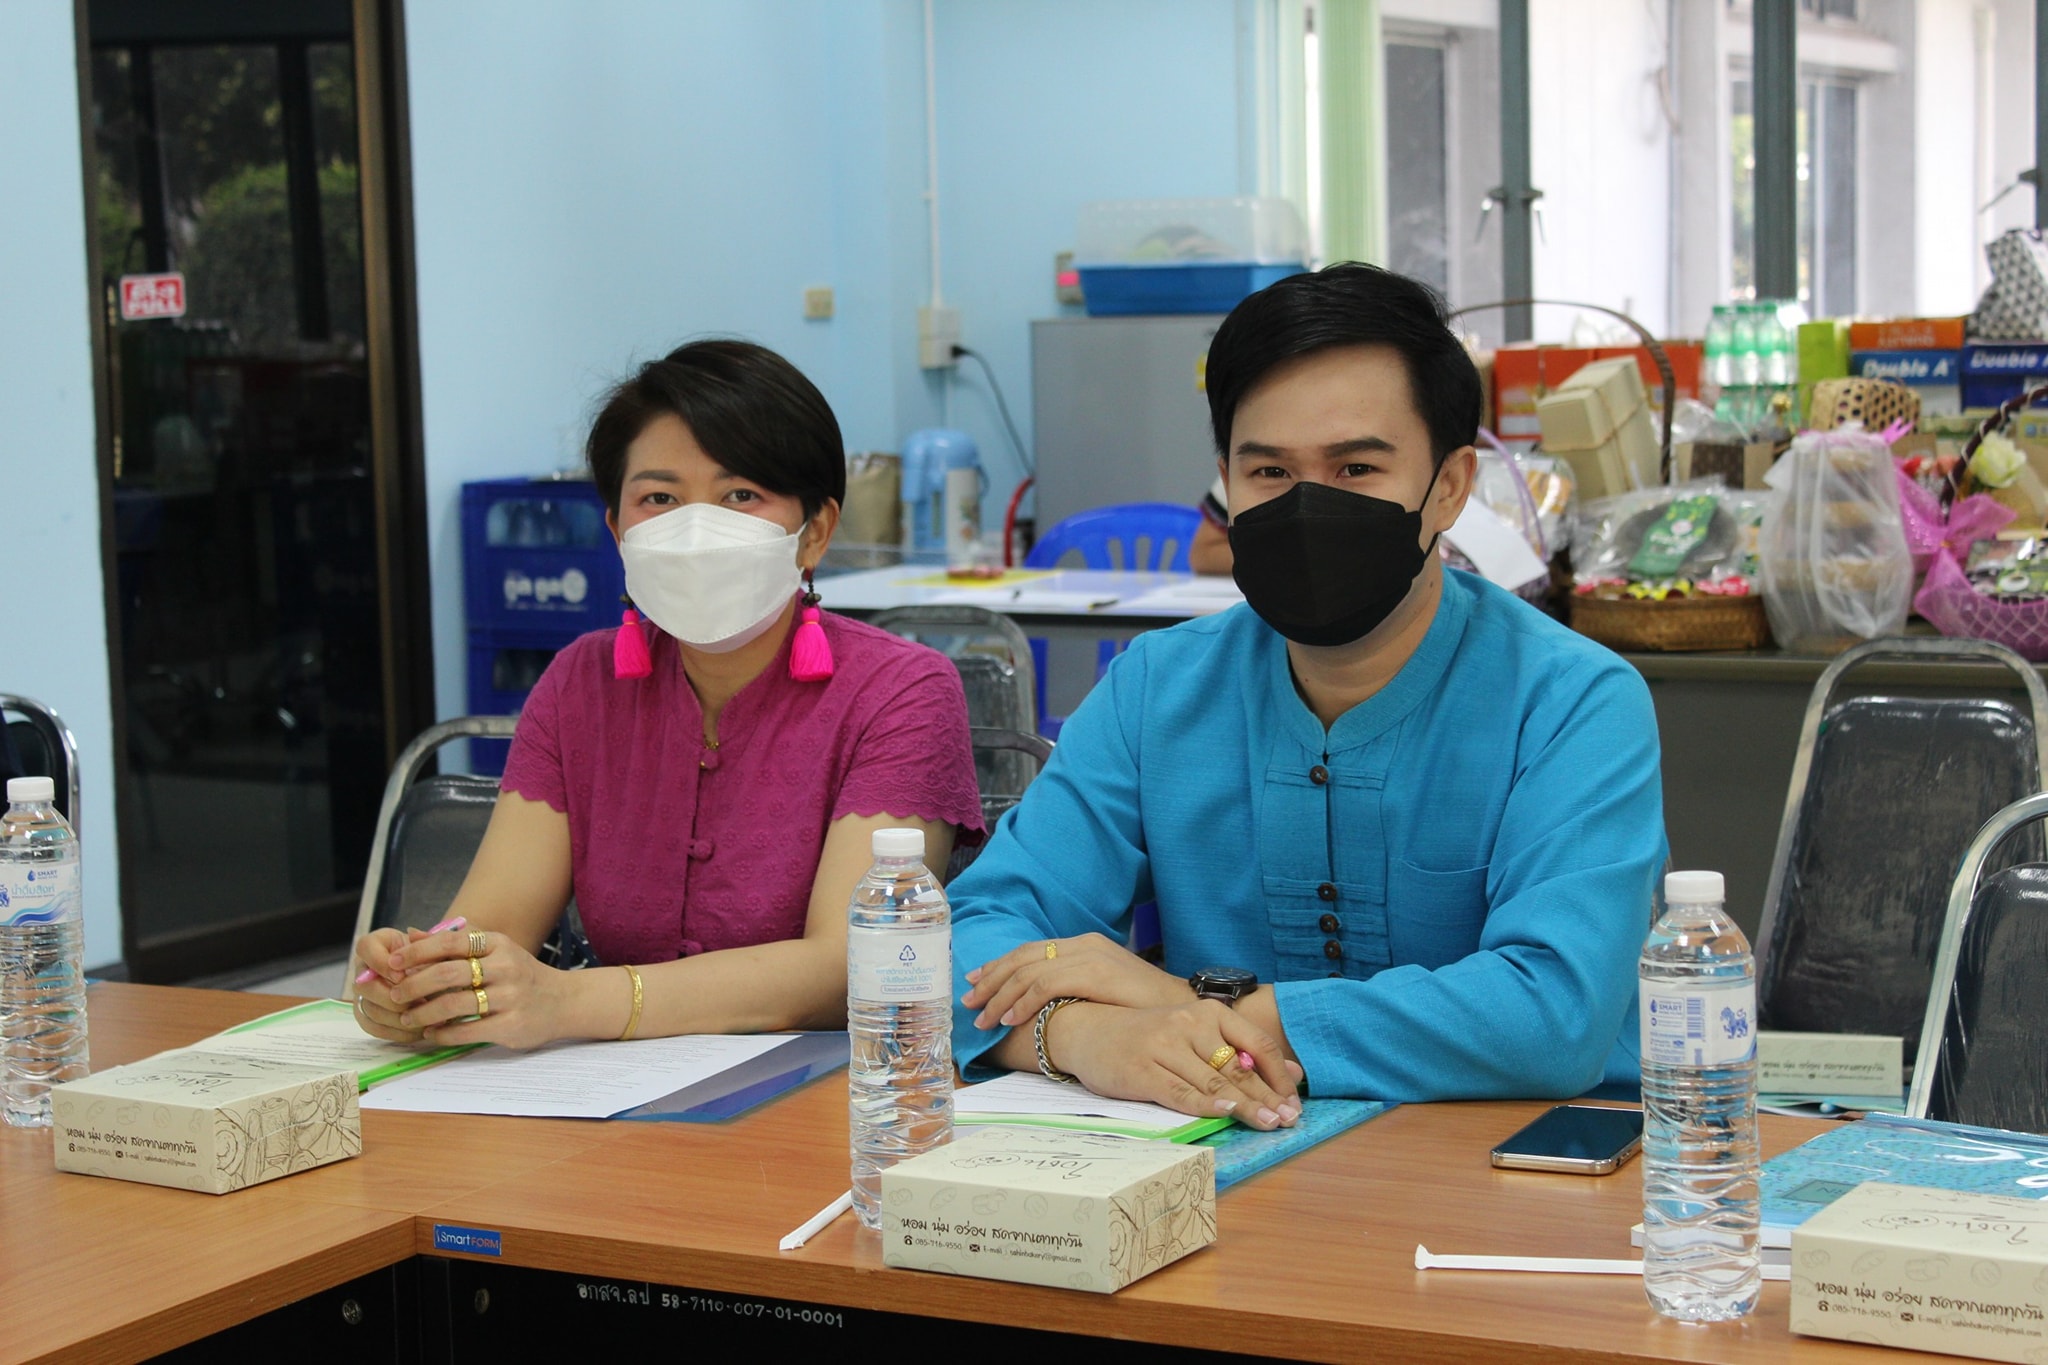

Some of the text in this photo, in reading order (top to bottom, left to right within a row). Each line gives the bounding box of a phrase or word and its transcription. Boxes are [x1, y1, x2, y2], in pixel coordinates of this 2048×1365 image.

[128, 299, 179, 317] PULL
[1862, 358, 1949, 378] Double A
[1970, 350, 2039, 369] Double
[66, 1127, 85, 1139] หอม
[88, 1128, 101, 1144] นุ่ม
[104, 1130, 127, 1145] อร่อย
[901, 1217, 1083, 1250] หอม นุ่ม อร่อย สดจากเตาทุกวัน
[915, 1238, 963, 1250] 085-716-9550
[1815, 1281, 2044, 1322] หอม นุ่ม อร่อย สดจากเตาทุกวัน
[1832, 1305, 1892, 1319] 085-716-9550
